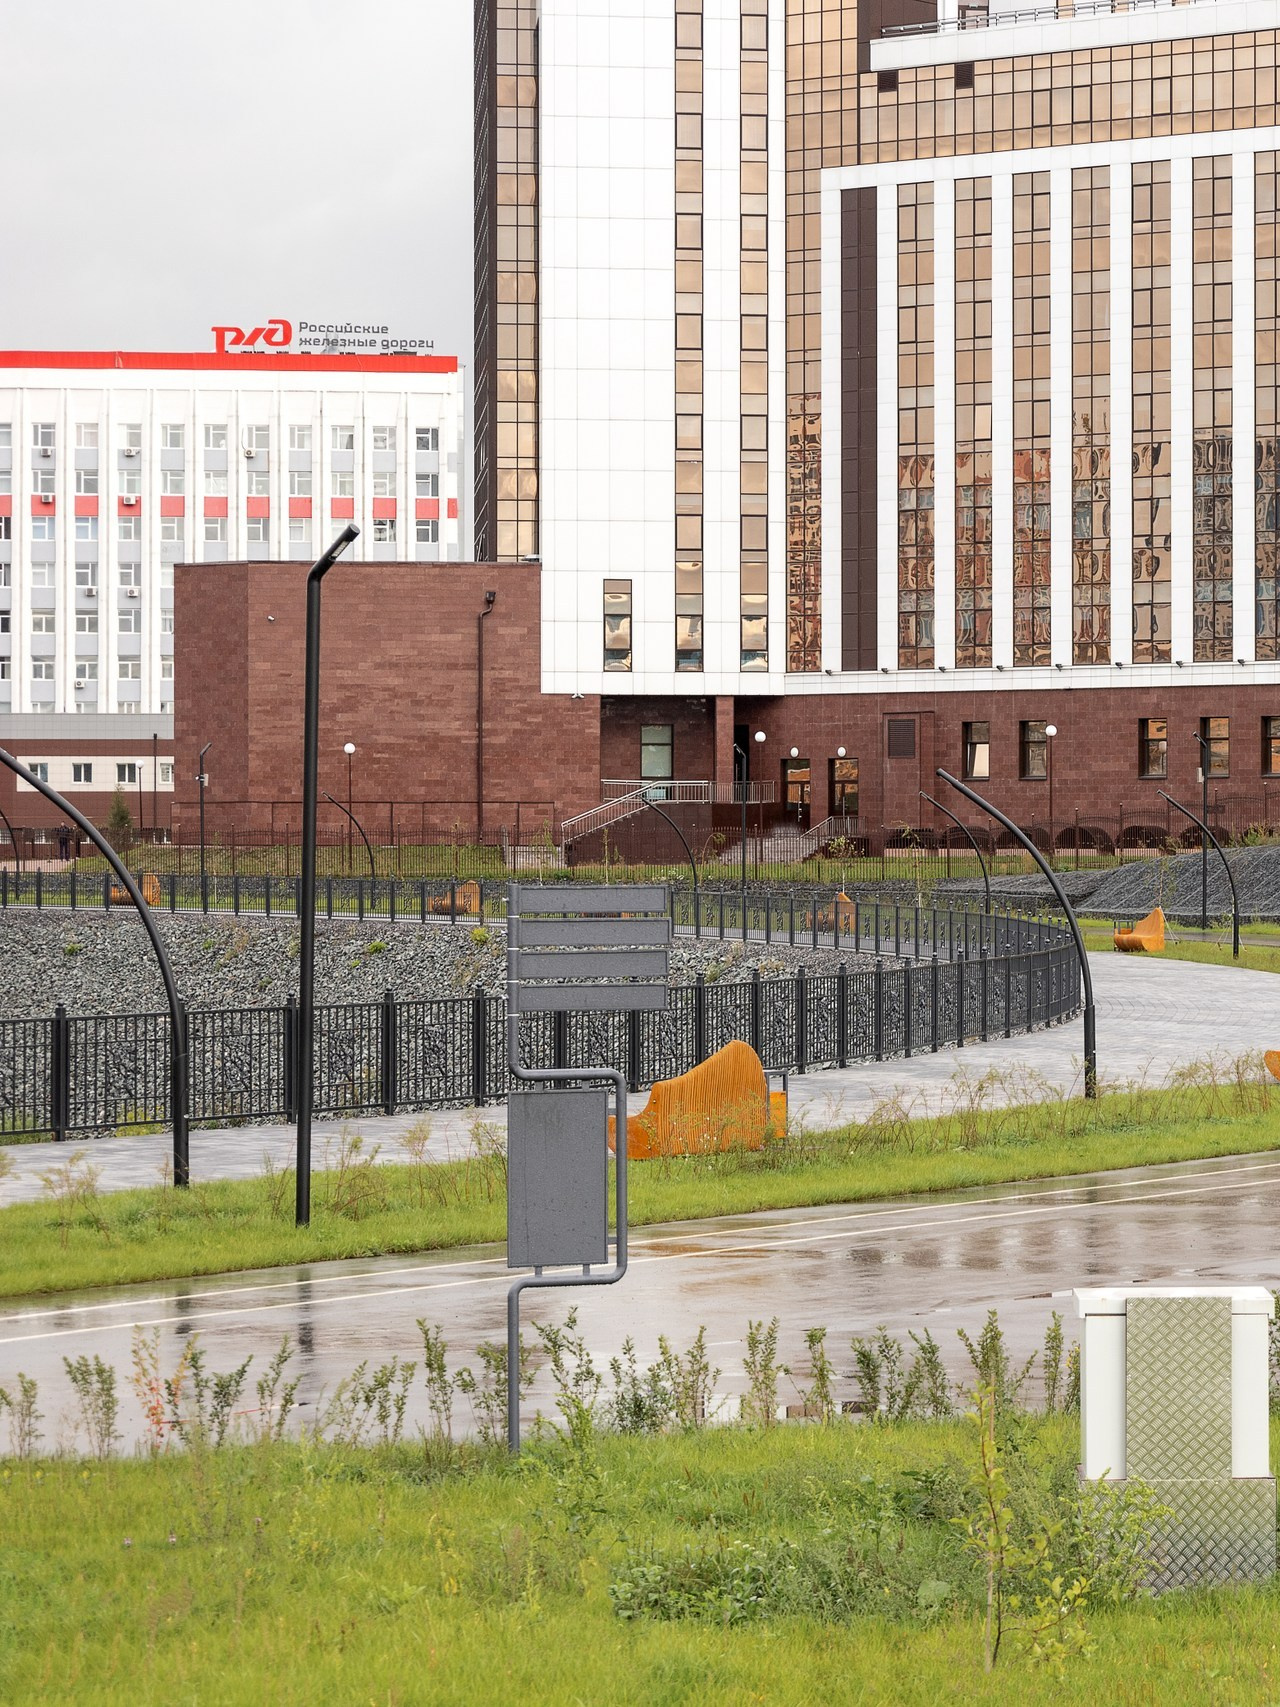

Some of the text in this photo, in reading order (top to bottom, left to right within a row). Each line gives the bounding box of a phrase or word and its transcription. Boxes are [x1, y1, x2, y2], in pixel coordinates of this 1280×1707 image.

[298, 321, 389, 334] Российские
[298, 336, 435, 350] железные дороги
